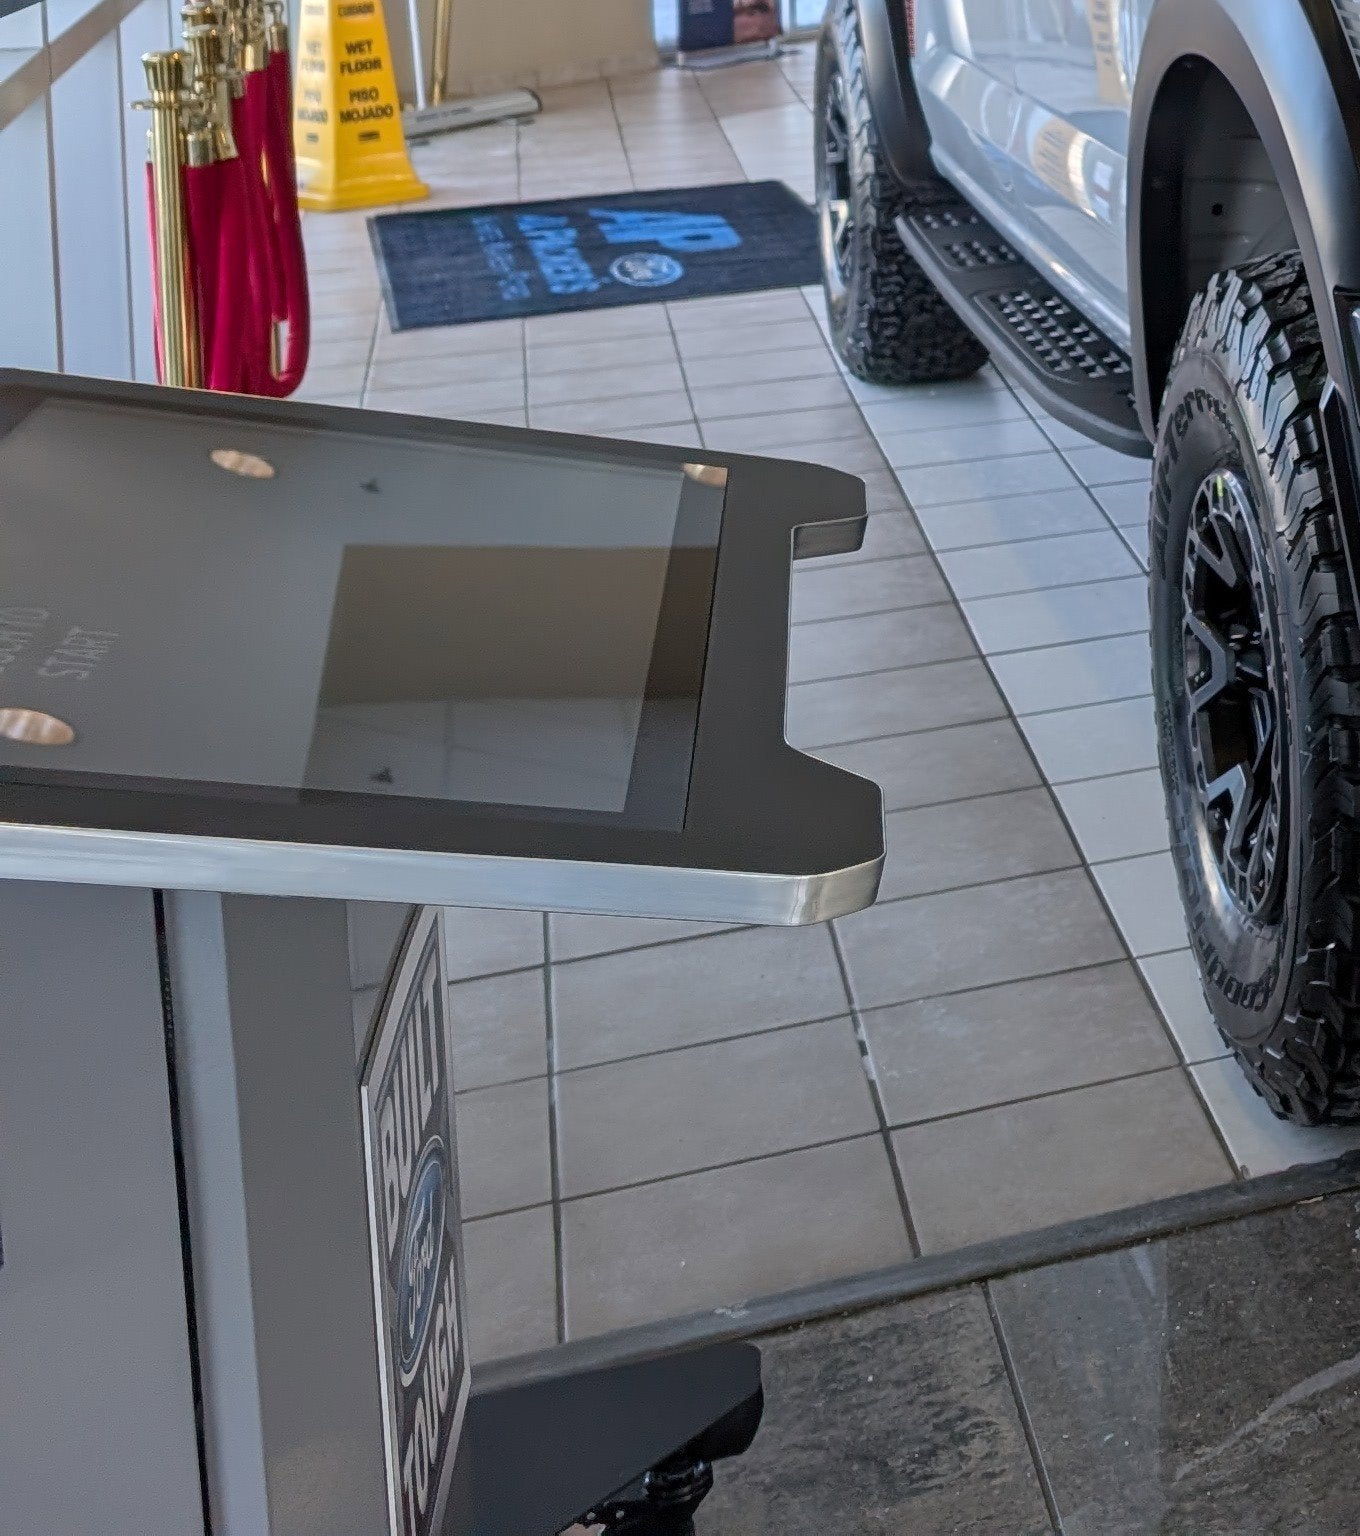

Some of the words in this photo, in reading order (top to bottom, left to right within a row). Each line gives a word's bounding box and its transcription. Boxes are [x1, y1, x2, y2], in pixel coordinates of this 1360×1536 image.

[339, 104, 394, 124] MOJADO
[345, 39, 373, 56] WET
[379, 951, 441, 1263] BUILT
[407, 1183, 435, 1341] Ford
[403, 1255, 459, 1536] TOUGH
